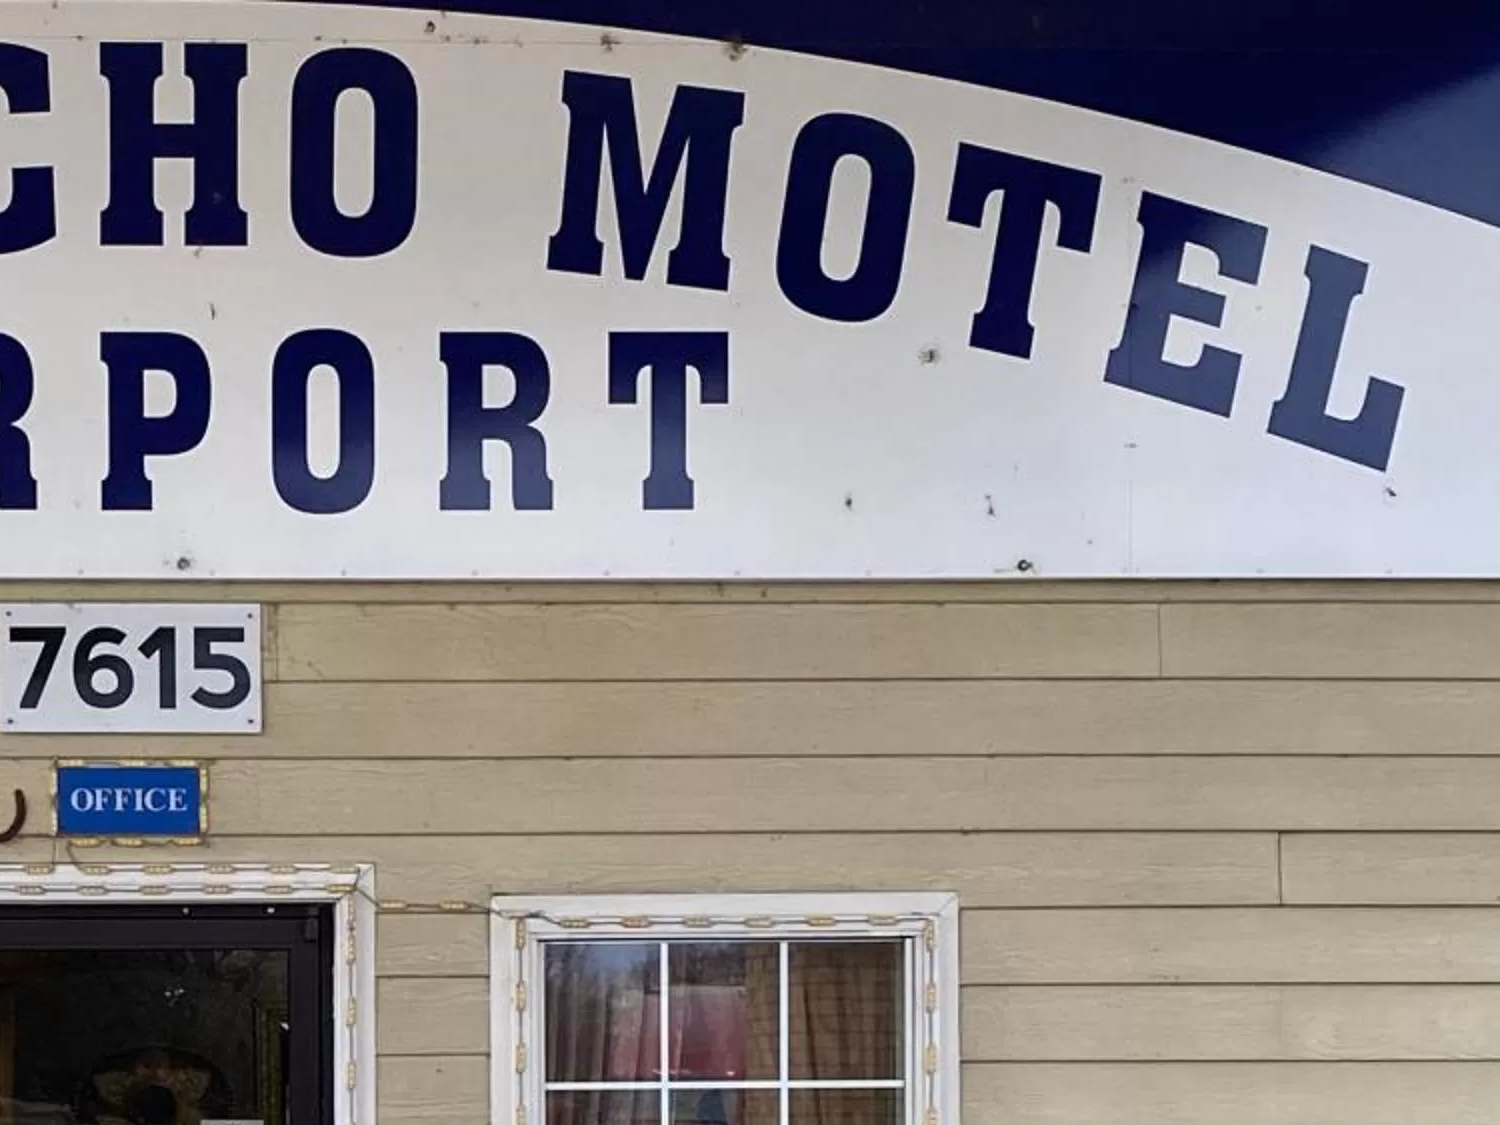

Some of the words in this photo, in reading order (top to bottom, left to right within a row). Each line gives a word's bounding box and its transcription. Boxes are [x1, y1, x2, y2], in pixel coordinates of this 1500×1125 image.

[546, 69, 1405, 473] MOTEL
[8, 626, 252, 710] 7615
[70, 787, 189, 812] OFFICE
